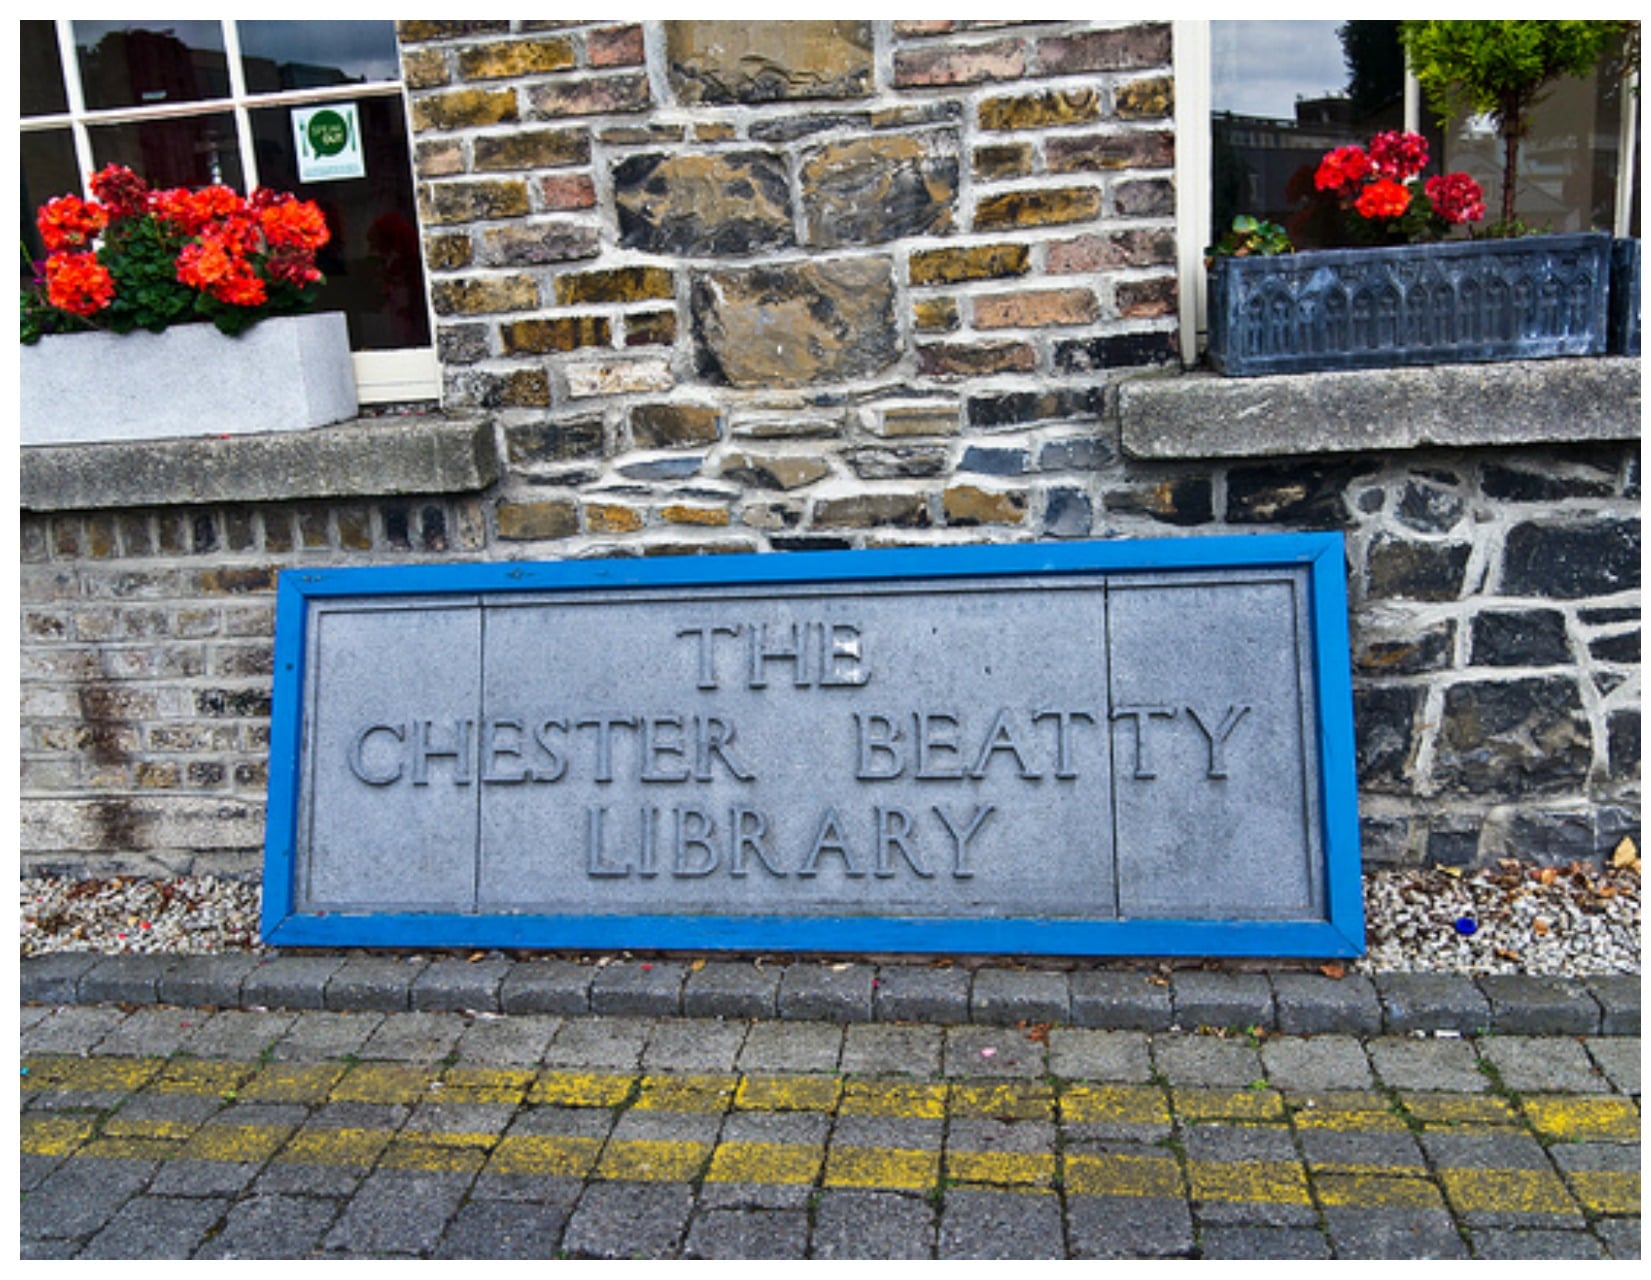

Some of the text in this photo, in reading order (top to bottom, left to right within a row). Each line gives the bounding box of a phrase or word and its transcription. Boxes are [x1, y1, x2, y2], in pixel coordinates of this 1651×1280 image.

[676, 621, 872, 690] THE
[347, 704, 1251, 786] CHESTER BEATTY
[585, 804, 996, 880] LIBRARY
